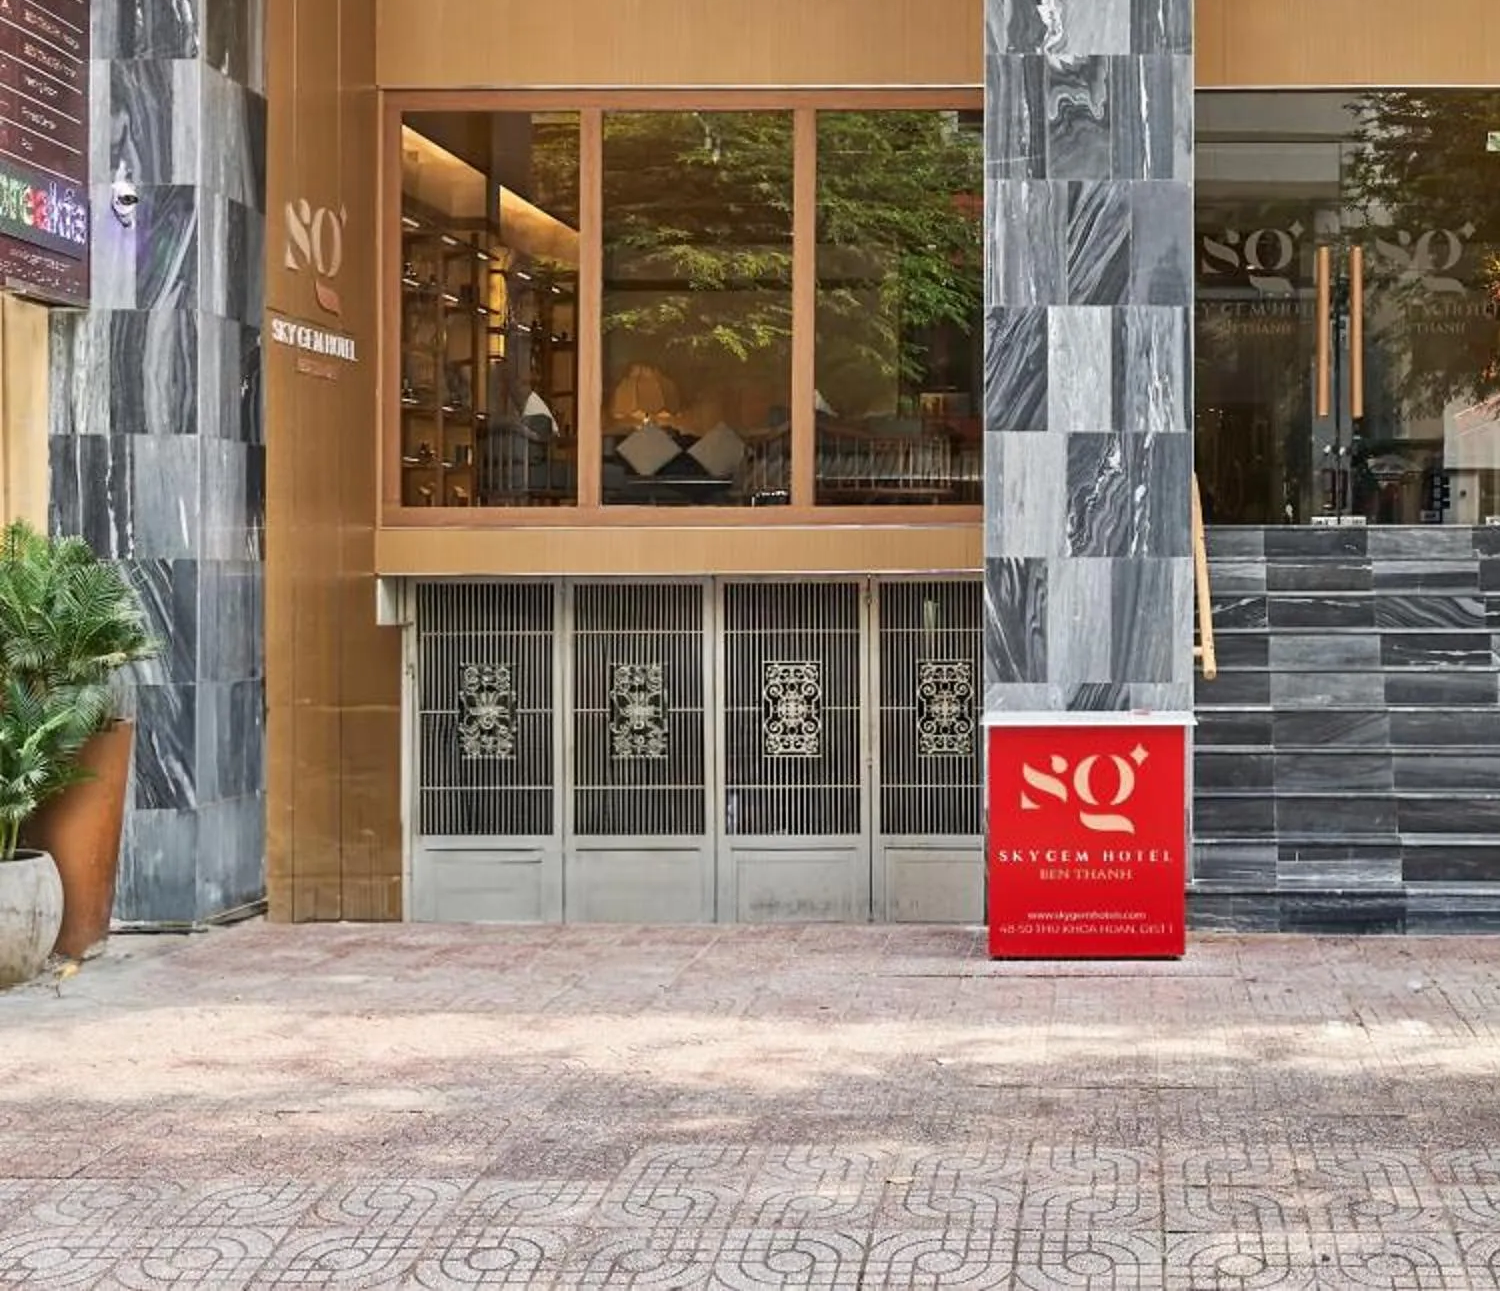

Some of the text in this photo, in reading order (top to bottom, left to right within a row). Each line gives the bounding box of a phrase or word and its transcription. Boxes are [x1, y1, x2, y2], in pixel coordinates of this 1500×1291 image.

[1103, 850, 1172, 862] HOTEL
[1040, 868, 1133, 880] BEN THANH
